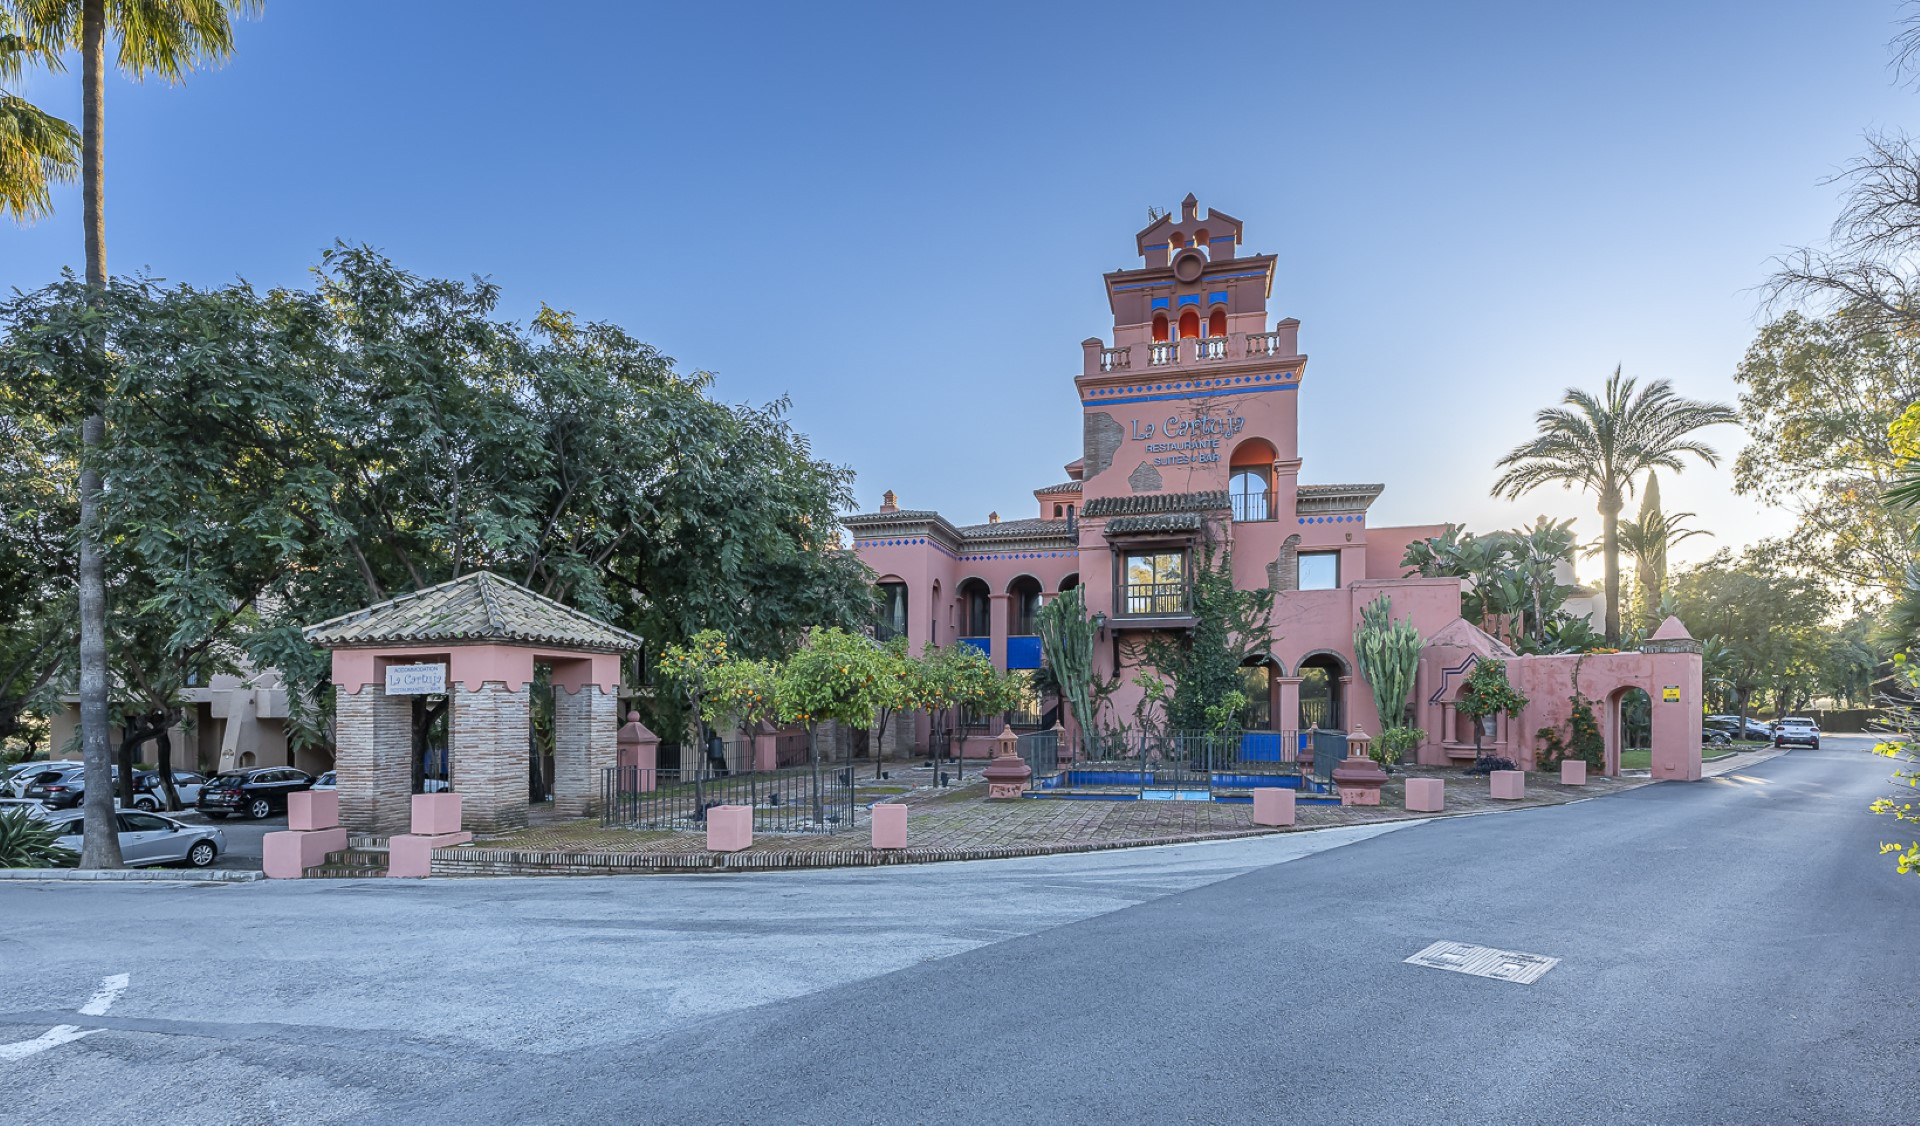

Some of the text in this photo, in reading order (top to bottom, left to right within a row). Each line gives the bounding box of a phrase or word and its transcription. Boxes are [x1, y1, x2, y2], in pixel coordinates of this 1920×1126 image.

[1131, 408, 1245, 441] La Cartuja
[1145, 439, 1220, 453] RESTAURANTE
[1153, 453, 1221, 467] SUITES BAR
[390, 672, 442, 686] La Cartuja
